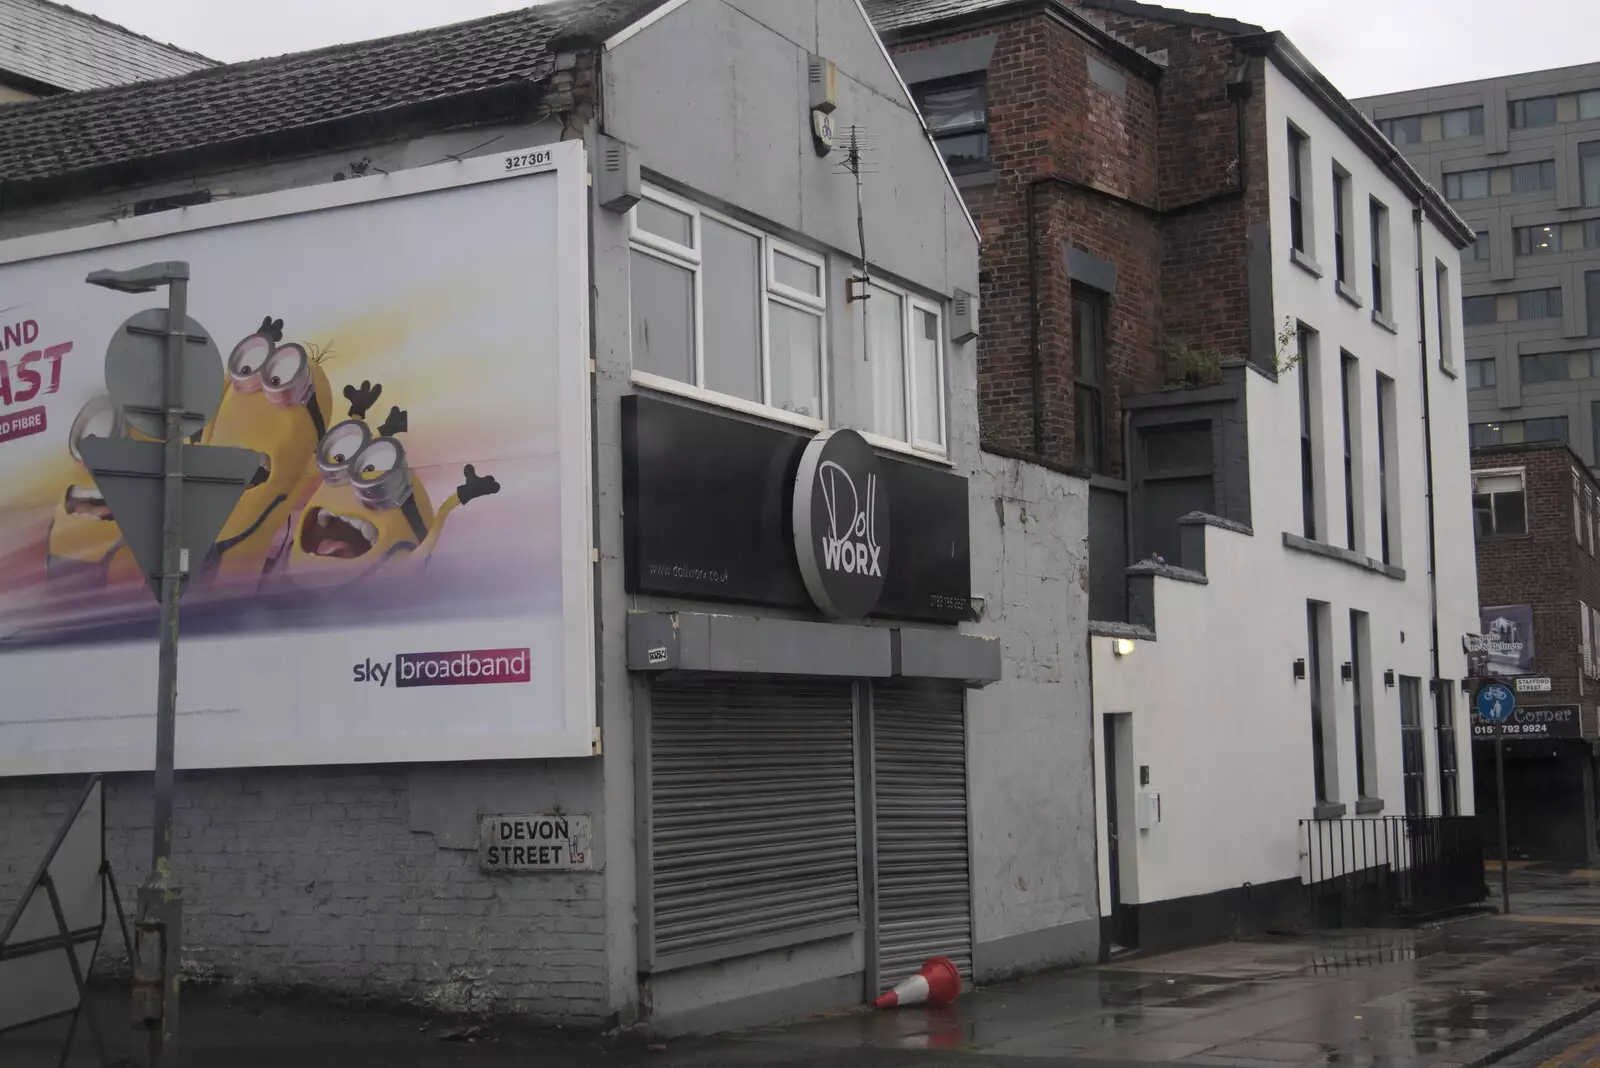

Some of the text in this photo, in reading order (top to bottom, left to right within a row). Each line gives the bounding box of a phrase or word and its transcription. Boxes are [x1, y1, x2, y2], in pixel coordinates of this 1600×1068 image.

[505, 150, 550, 169] 327301
[0, 319, 39, 352] ND
[12, 414, 42, 432] FIBRE
[819, 460, 877, 547] Doll
[822, 536, 882, 577] WORX
[353, 651, 526, 687] sky broadband
[1514, 708, 1572, 723] Corner
[1474, 724, 1548, 734] 015 792 9924
[500, 821, 569, 840] DEVON
[487, 845, 563, 865] STREET
